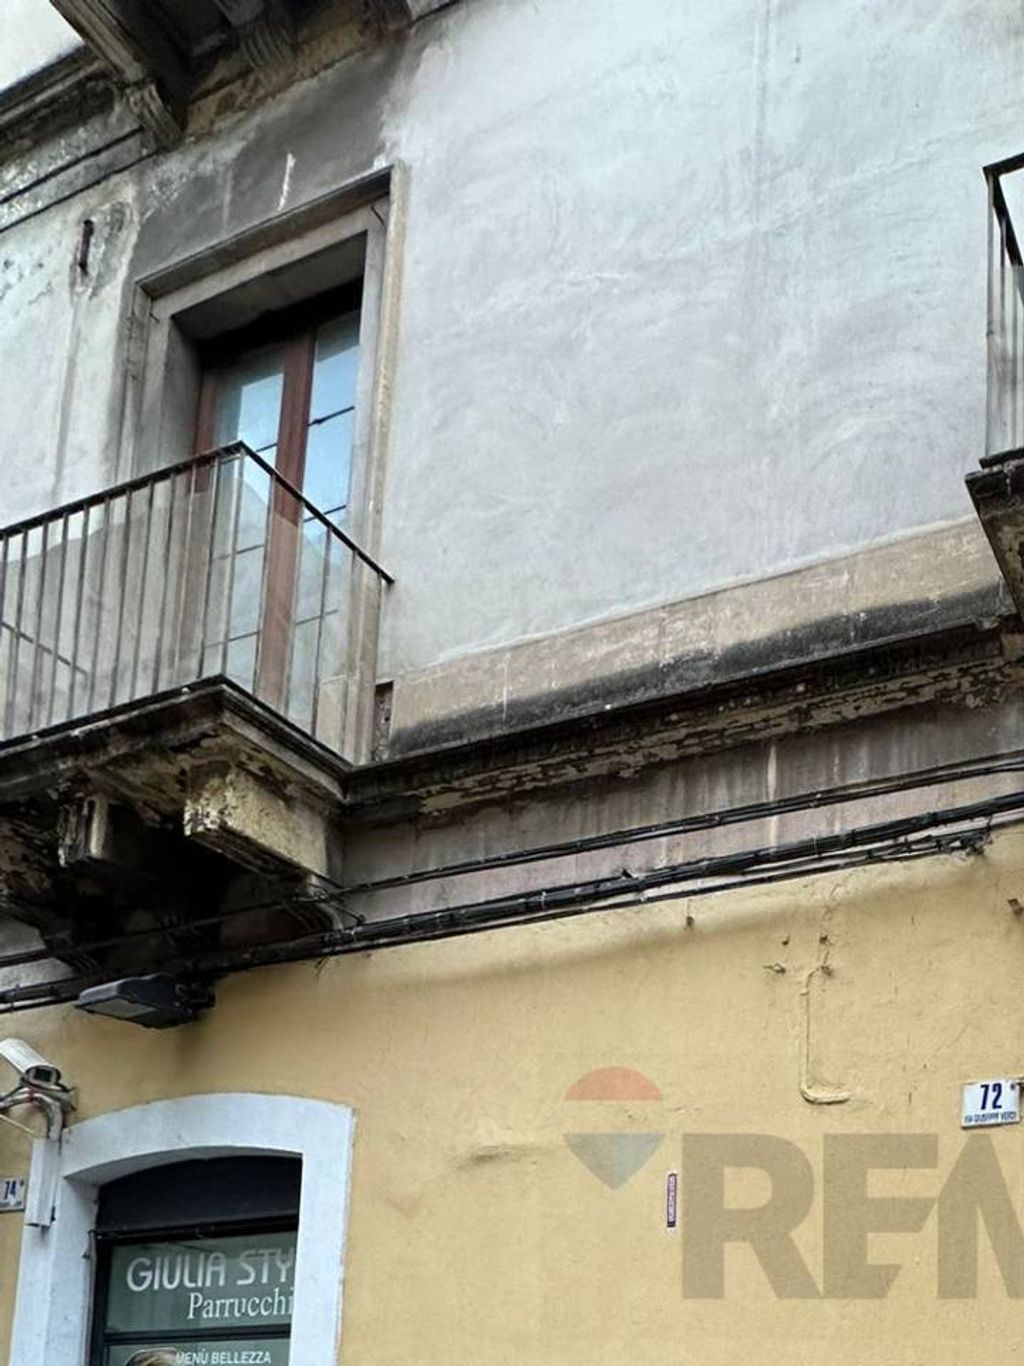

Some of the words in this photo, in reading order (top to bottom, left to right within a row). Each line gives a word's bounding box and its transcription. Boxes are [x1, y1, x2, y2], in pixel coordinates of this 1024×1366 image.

[980, 1083, 1002, 1110] 72
[126, 1252, 225, 1291] GIULIA
[237, 1247, 296, 1285] STY
[211, 1351, 272, 1364] BELLEZZA
